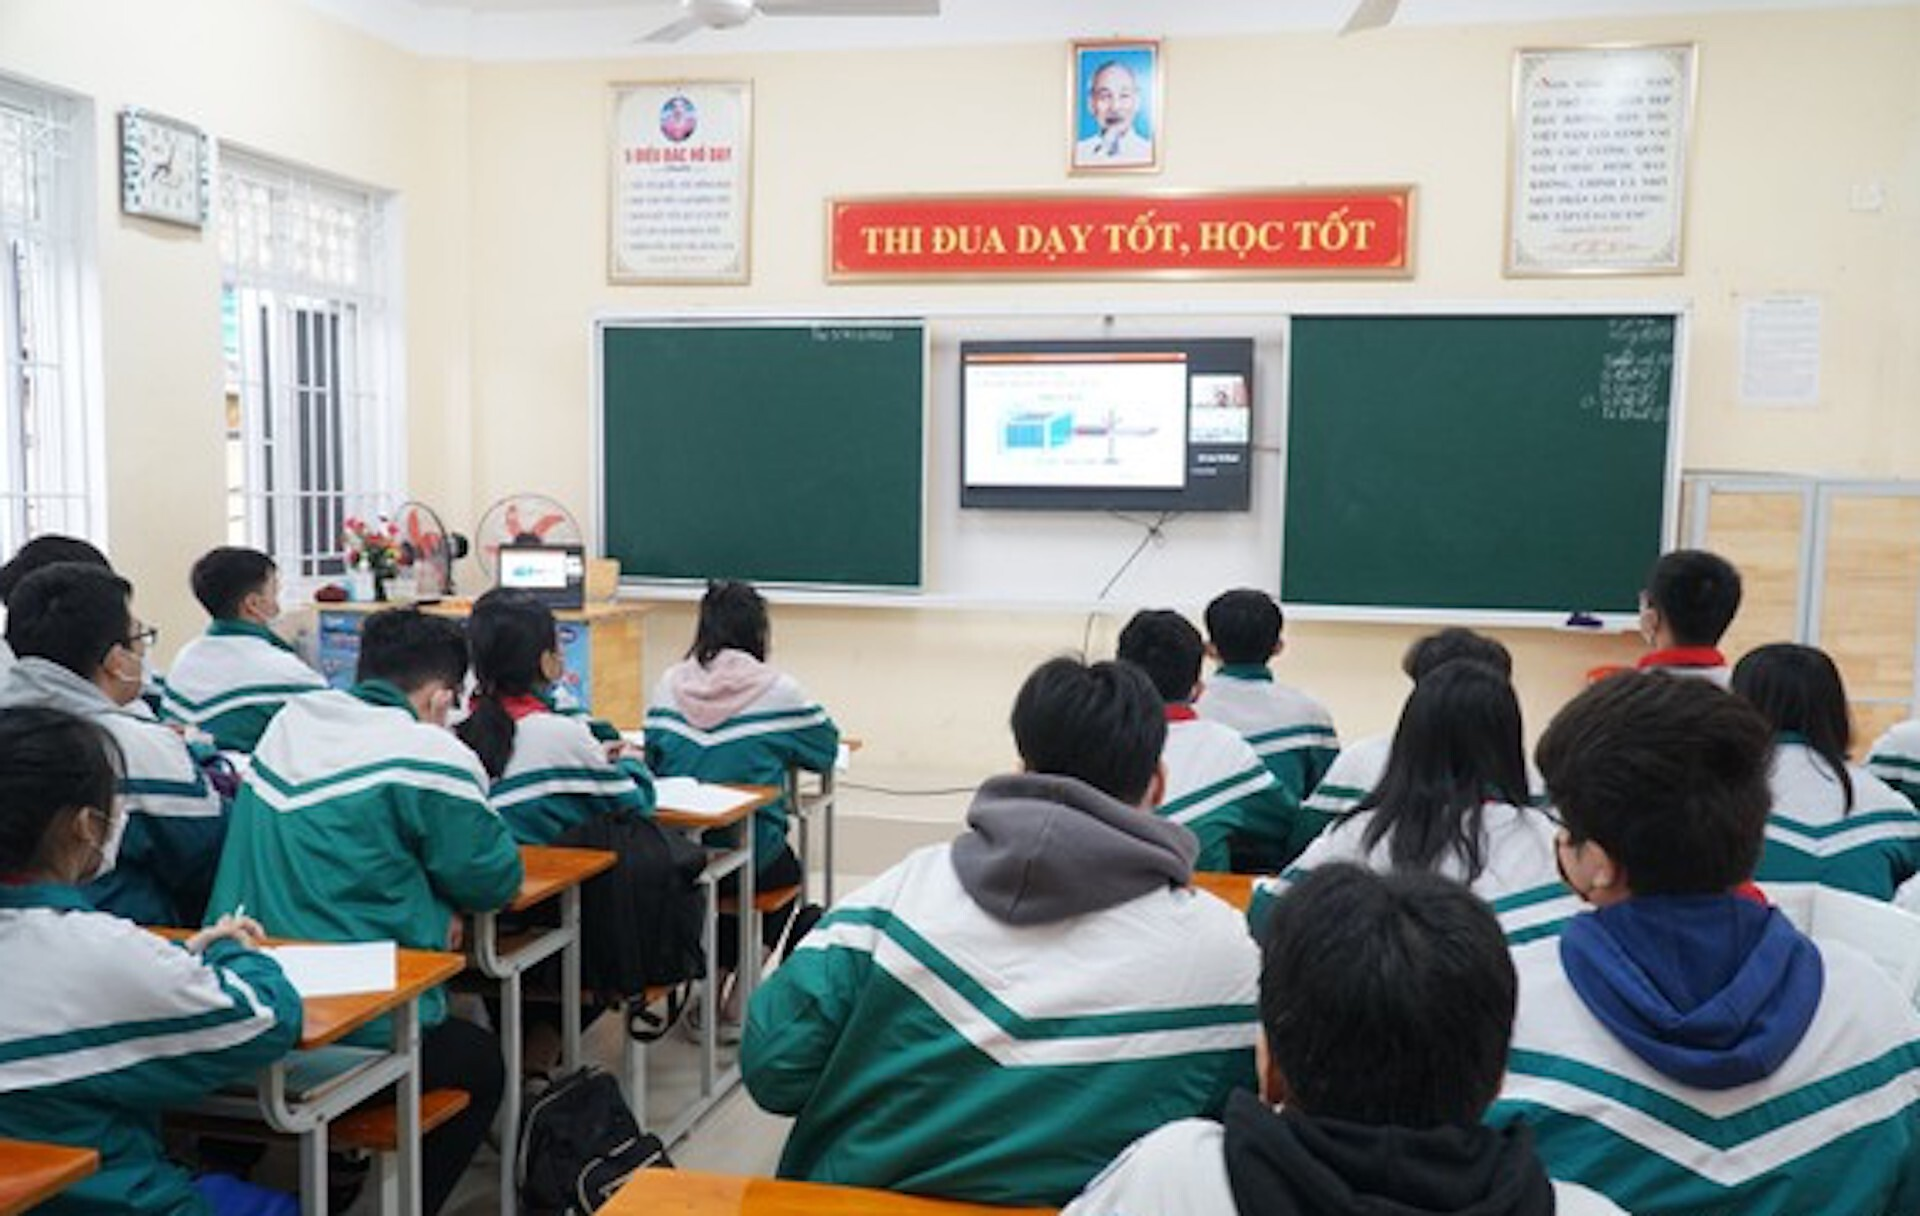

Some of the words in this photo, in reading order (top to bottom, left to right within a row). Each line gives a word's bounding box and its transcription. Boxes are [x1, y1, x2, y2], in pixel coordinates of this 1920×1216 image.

[861, 226, 923, 254] THI
[931, 225, 1007, 254] ĐUA
[1016, 224, 1094, 261] DẠY
[1103, 209, 1191, 258] TỐT,
[1199, 221, 1286, 260] HỌC
[1293, 206, 1376, 251] TỐT
